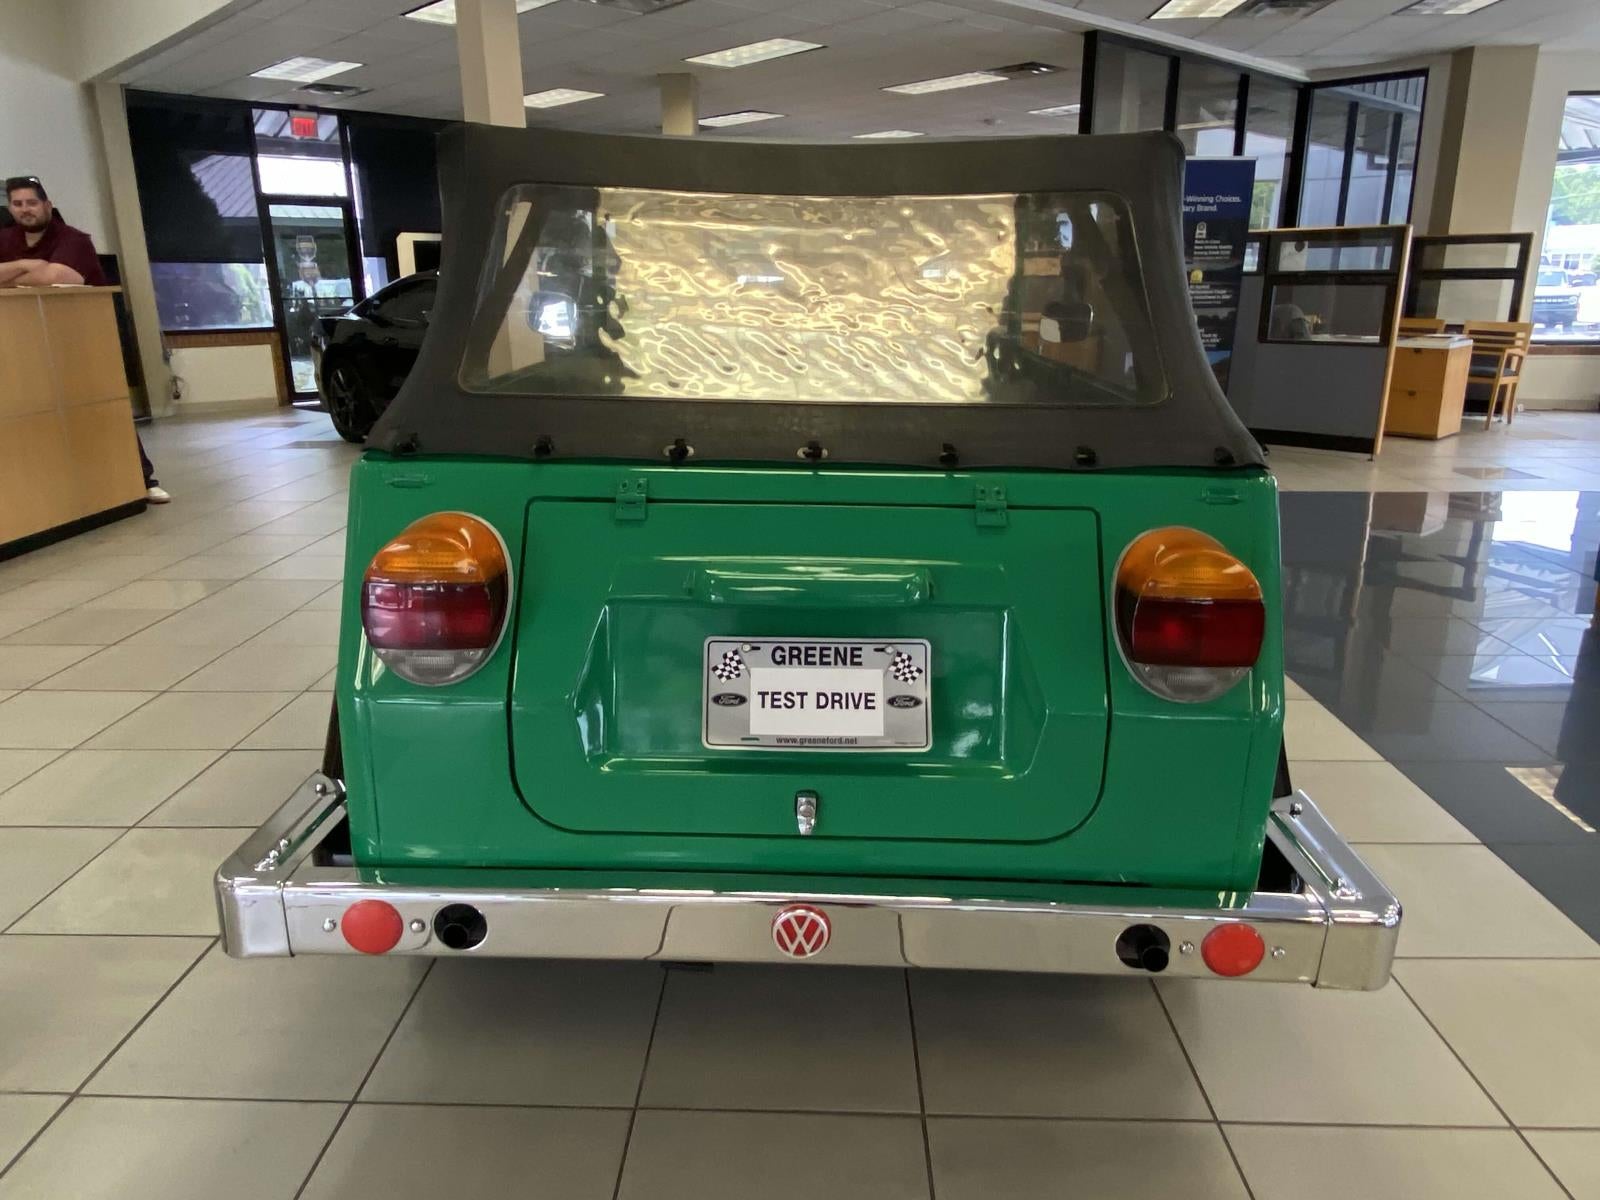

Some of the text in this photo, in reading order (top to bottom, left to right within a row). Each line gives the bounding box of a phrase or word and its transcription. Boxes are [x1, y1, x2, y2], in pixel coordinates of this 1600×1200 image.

[771, 645, 863, 667] GREENE
[717, 694, 742, 706] Ford
[757, 691, 876, 710] TEST DRIVE
[893, 696, 917, 708] Ford
